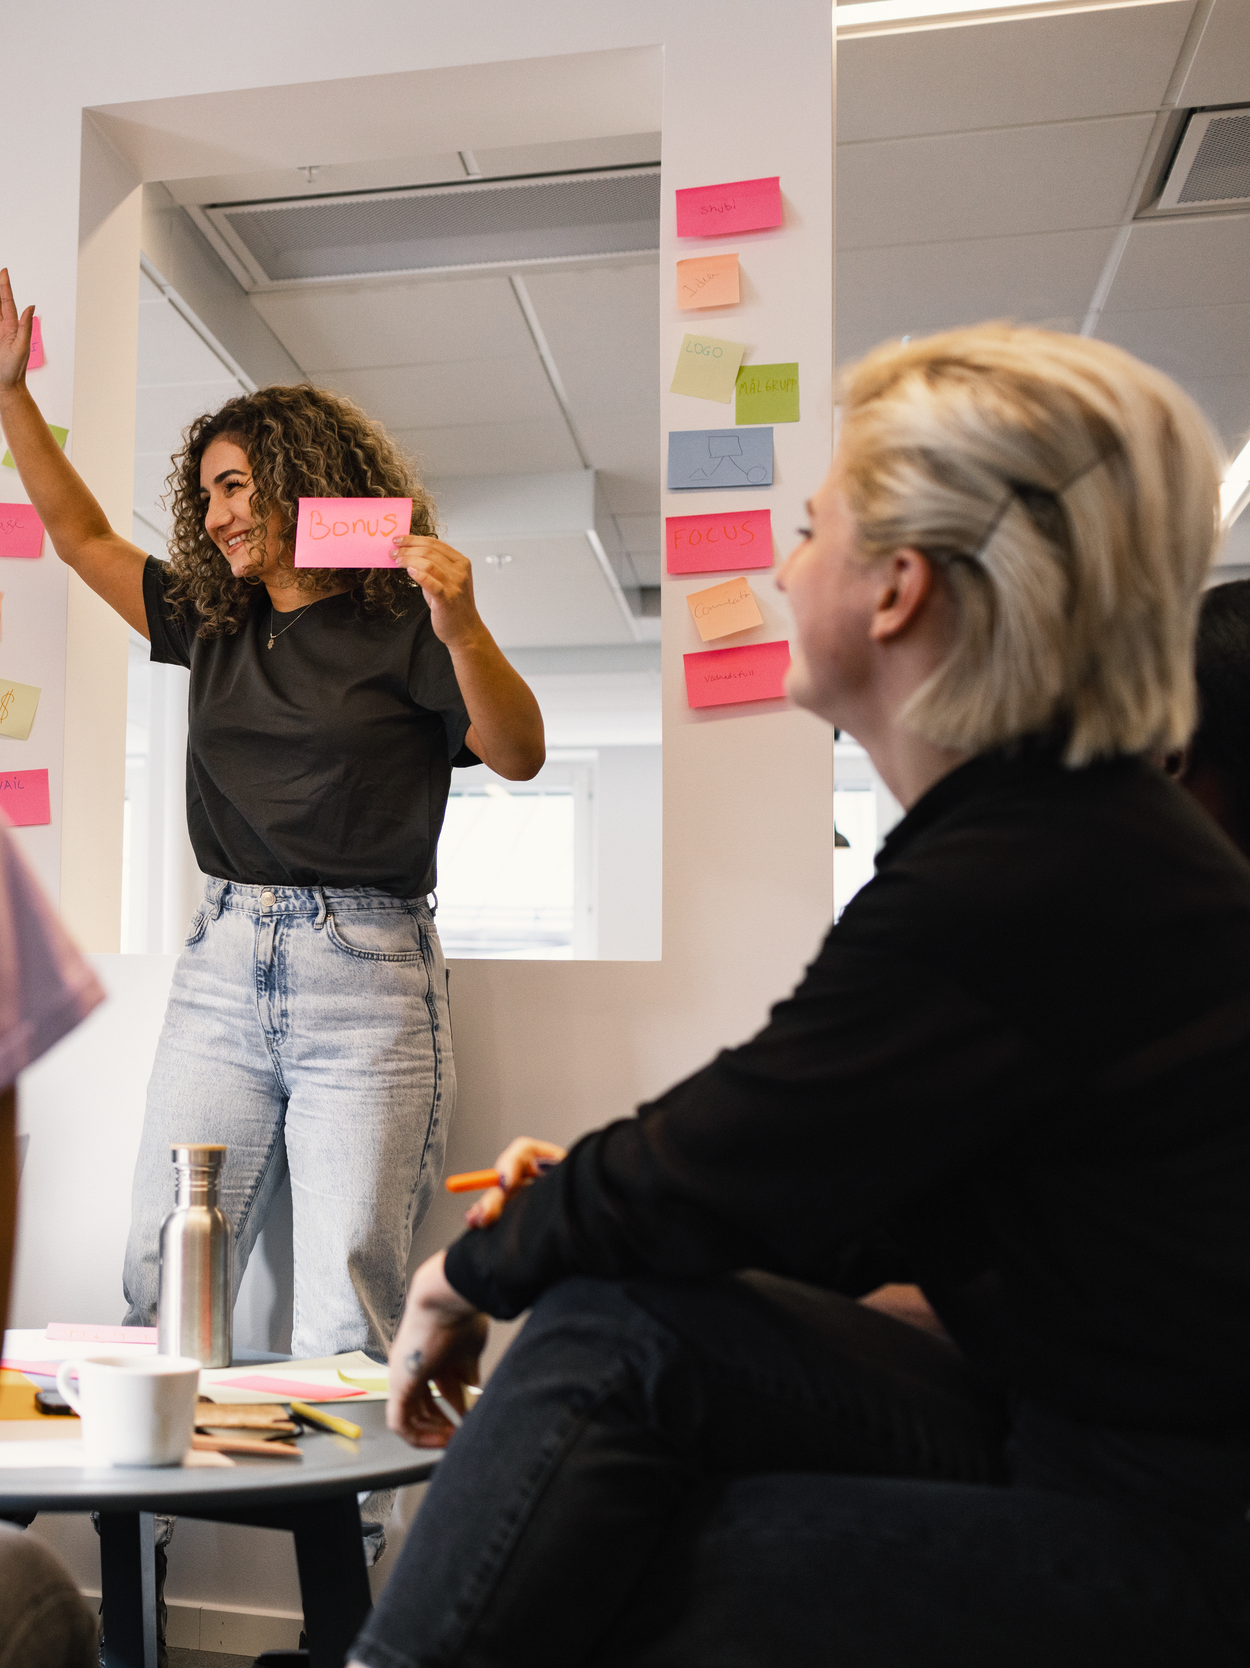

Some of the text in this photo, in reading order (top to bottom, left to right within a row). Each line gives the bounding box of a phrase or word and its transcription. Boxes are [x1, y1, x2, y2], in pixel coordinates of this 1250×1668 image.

[685, 341, 723, 359] LOGO
[309, 509, 398, 541] Bonus
[674, 520, 755, 550] FOCUS
